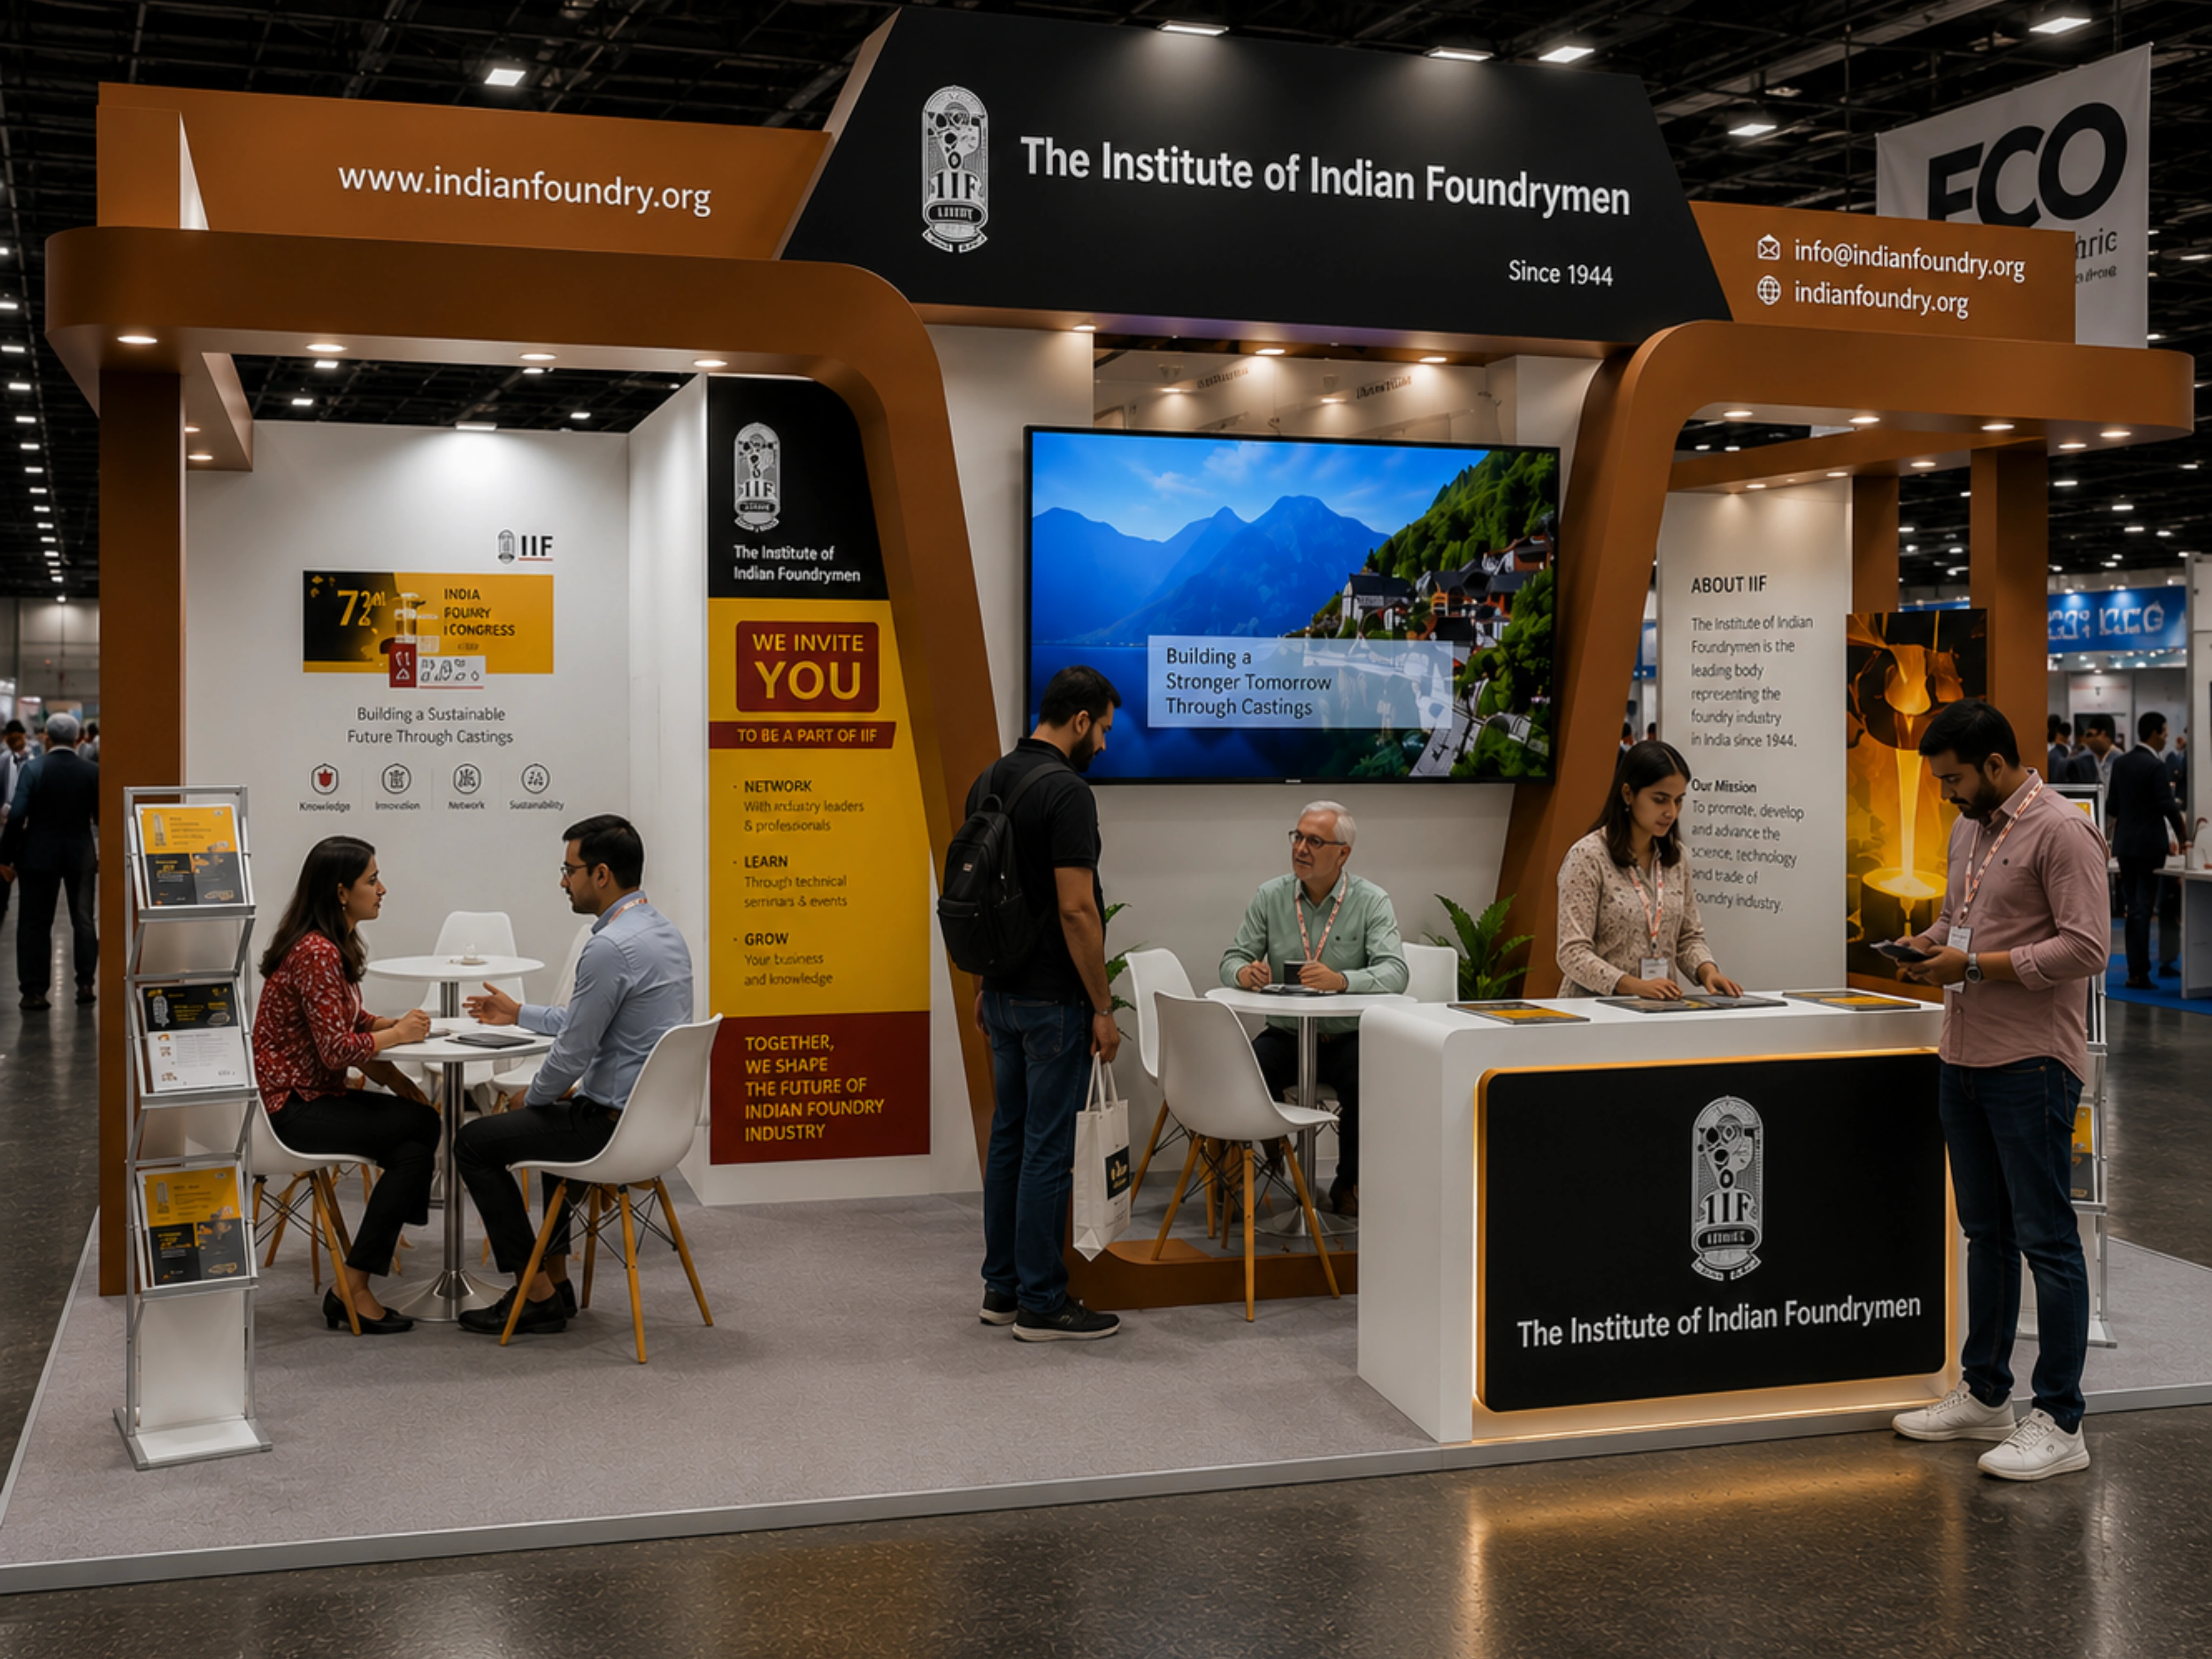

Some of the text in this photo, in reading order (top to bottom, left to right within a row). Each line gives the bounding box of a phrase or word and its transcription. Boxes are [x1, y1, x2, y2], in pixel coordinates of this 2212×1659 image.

[1021, 137, 1629, 218] The Institute of Indian Foundrymen
[338, 165, 710, 217] www.indianfoundry.org
[1796, 239, 2025, 283] info@indianfoundry.org
[1509, 260, 1613, 286] Since 1944
[1796, 281, 1969, 319] indianfoundry.org
[522, 536, 553, 556] IIF
[733, 545, 834, 561] The Institute of
[734, 565, 860, 584] Indian Foundrymen
[1691, 575, 1767, 593] ABOUT IIF
[444, 588, 480, 599] INDIA
[1692, 615, 1813, 631] The Institute of Indian
[753, 634, 863, 651] WE INVITE
[1692, 639, 1795, 656] Foundrymen is the
[1167, 647, 1251, 669] Building a
[755, 661, 860, 699] YOU
[1692, 664, 1763, 680] leading body
[1167, 672, 1332, 694] Stronger Tomorrow
[1691, 687, 1781, 704] representing the
[358, 707, 505, 724] Building a Sustainable
[1166, 697, 1313, 719] Through Castings
[1691, 709, 1733, 727] foundry
[348, 730, 514, 746] Future Through Castings
[737, 729, 877, 742] TO BE A PART OF IIF
[1691, 733, 1797, 747] in India since 1944.
[745, 780, 811, 792] NETWORK
[1691, 779, 1756, 793] Our Mission
[744, 801, 771, 812] With
[824, 800, 864, 812] leaders
[1693, 800, 1705, 813] To
[1759, 804, 1804, 822] develop
[744, 820, 753, 831] &
[1692, 824, 1780, 841] and advance the
[745, 856, 787, 868] LEARN
[745, 875, 846, 891] Through technical
[1715, 870, 1743, 883] trade
[1746, 871, 1758, 884] of
[798, 895, 806, 907] &
[810, 897, 847, 907] events
[1694, 889, 1733, 909] oundry
[745, 933, 788, 945] GROW
[745, 955, 770, 966] Your
[745, 973, 766, 986] and
[745, 1035, 833, 1051] TOGETHER,
[745, 1057, 828, 1074] WE SHAPE
[745, 1078, 867, 1096] THE FUTURE OF
[746, 1099, 884, 1119] INDIAN FOUNDRY
[746, 1124, 825, 1141] INDUSTRY
[1517, 1295, 1920, 1347] The Institute of Indian Foundrymen
